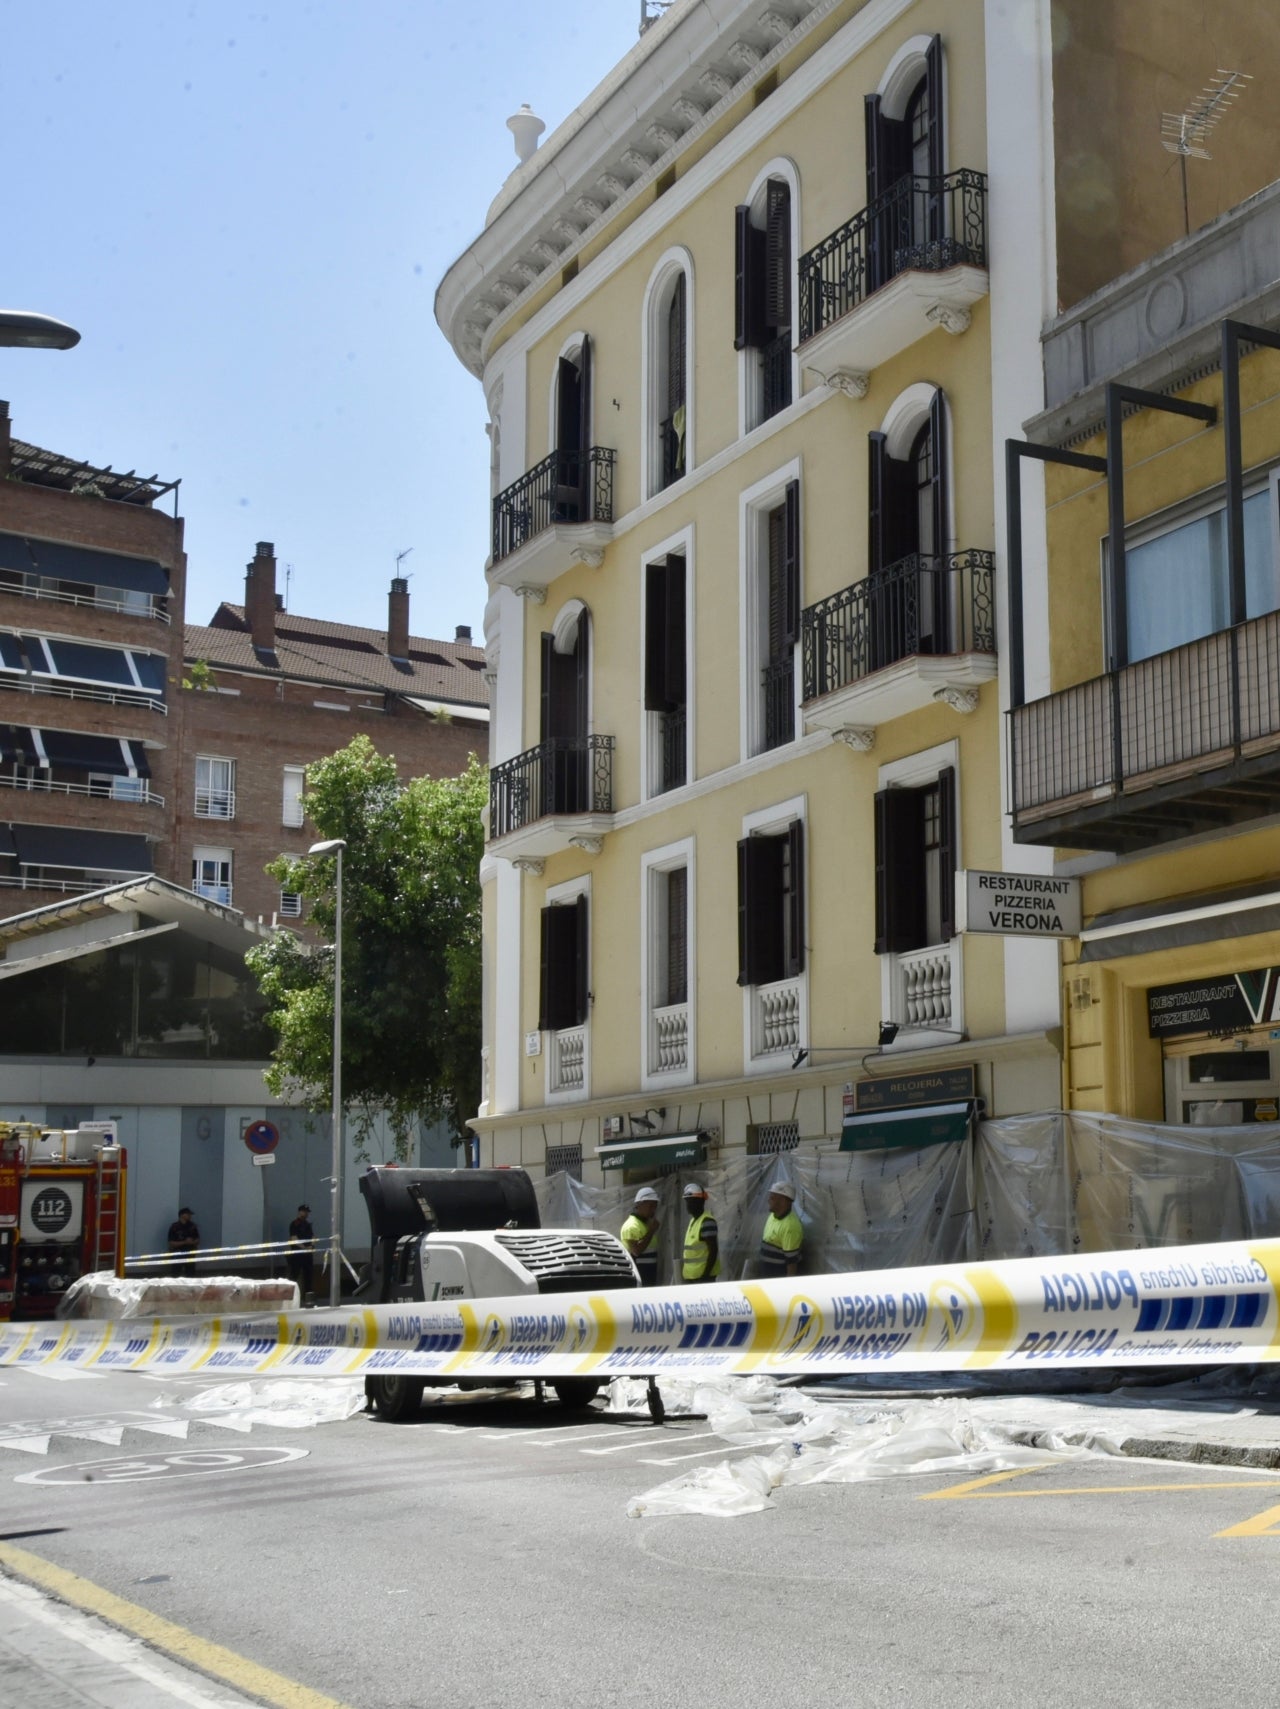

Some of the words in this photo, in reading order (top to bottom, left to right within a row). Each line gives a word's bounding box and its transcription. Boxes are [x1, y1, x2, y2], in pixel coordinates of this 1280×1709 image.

[978, 876, 1070, 895] RESTAURANT
[994, 894, 1056, 911] PIZZERIA
[988, 911, 1064, 932] VERONA
[1150, 984, 1237, 1011] RESTAURANT
[1151, 1007, 1211, 1028] PIZZERIA
[890, 1078, 944, 1093] RELOJERIA
[38, 1200, 65, 1215] 112
[802, 1335, 840, 1360] NO
[830, 1333, 912, 1360] PASSEU
[1008, 1328, 1119, 1360] POLICIA
[1176, 1337, 1242, 1355] Urbana
[77, 1453, 245, 1478] 30
